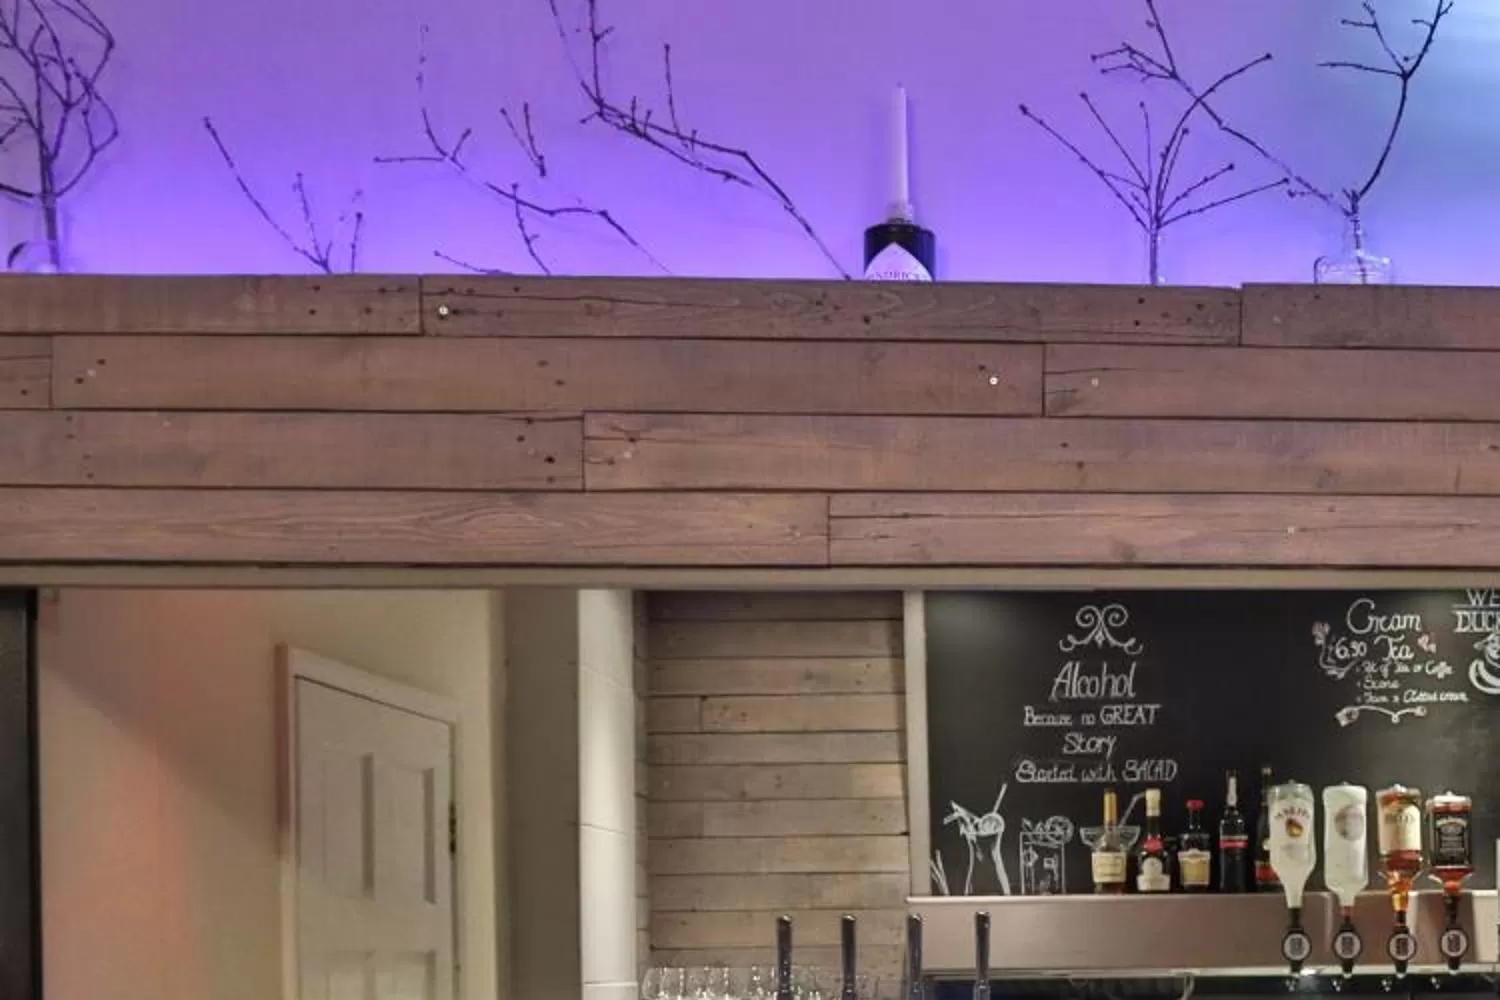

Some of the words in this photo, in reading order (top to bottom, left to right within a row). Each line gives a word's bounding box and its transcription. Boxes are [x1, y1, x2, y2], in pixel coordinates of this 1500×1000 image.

[1347, 598, 1421, 634] Cream
[1048, 660, 1137, 703] Alcohol
[1100, 703, 1163, 725] GREAT
[1062, 731, 1117, 760] Story
